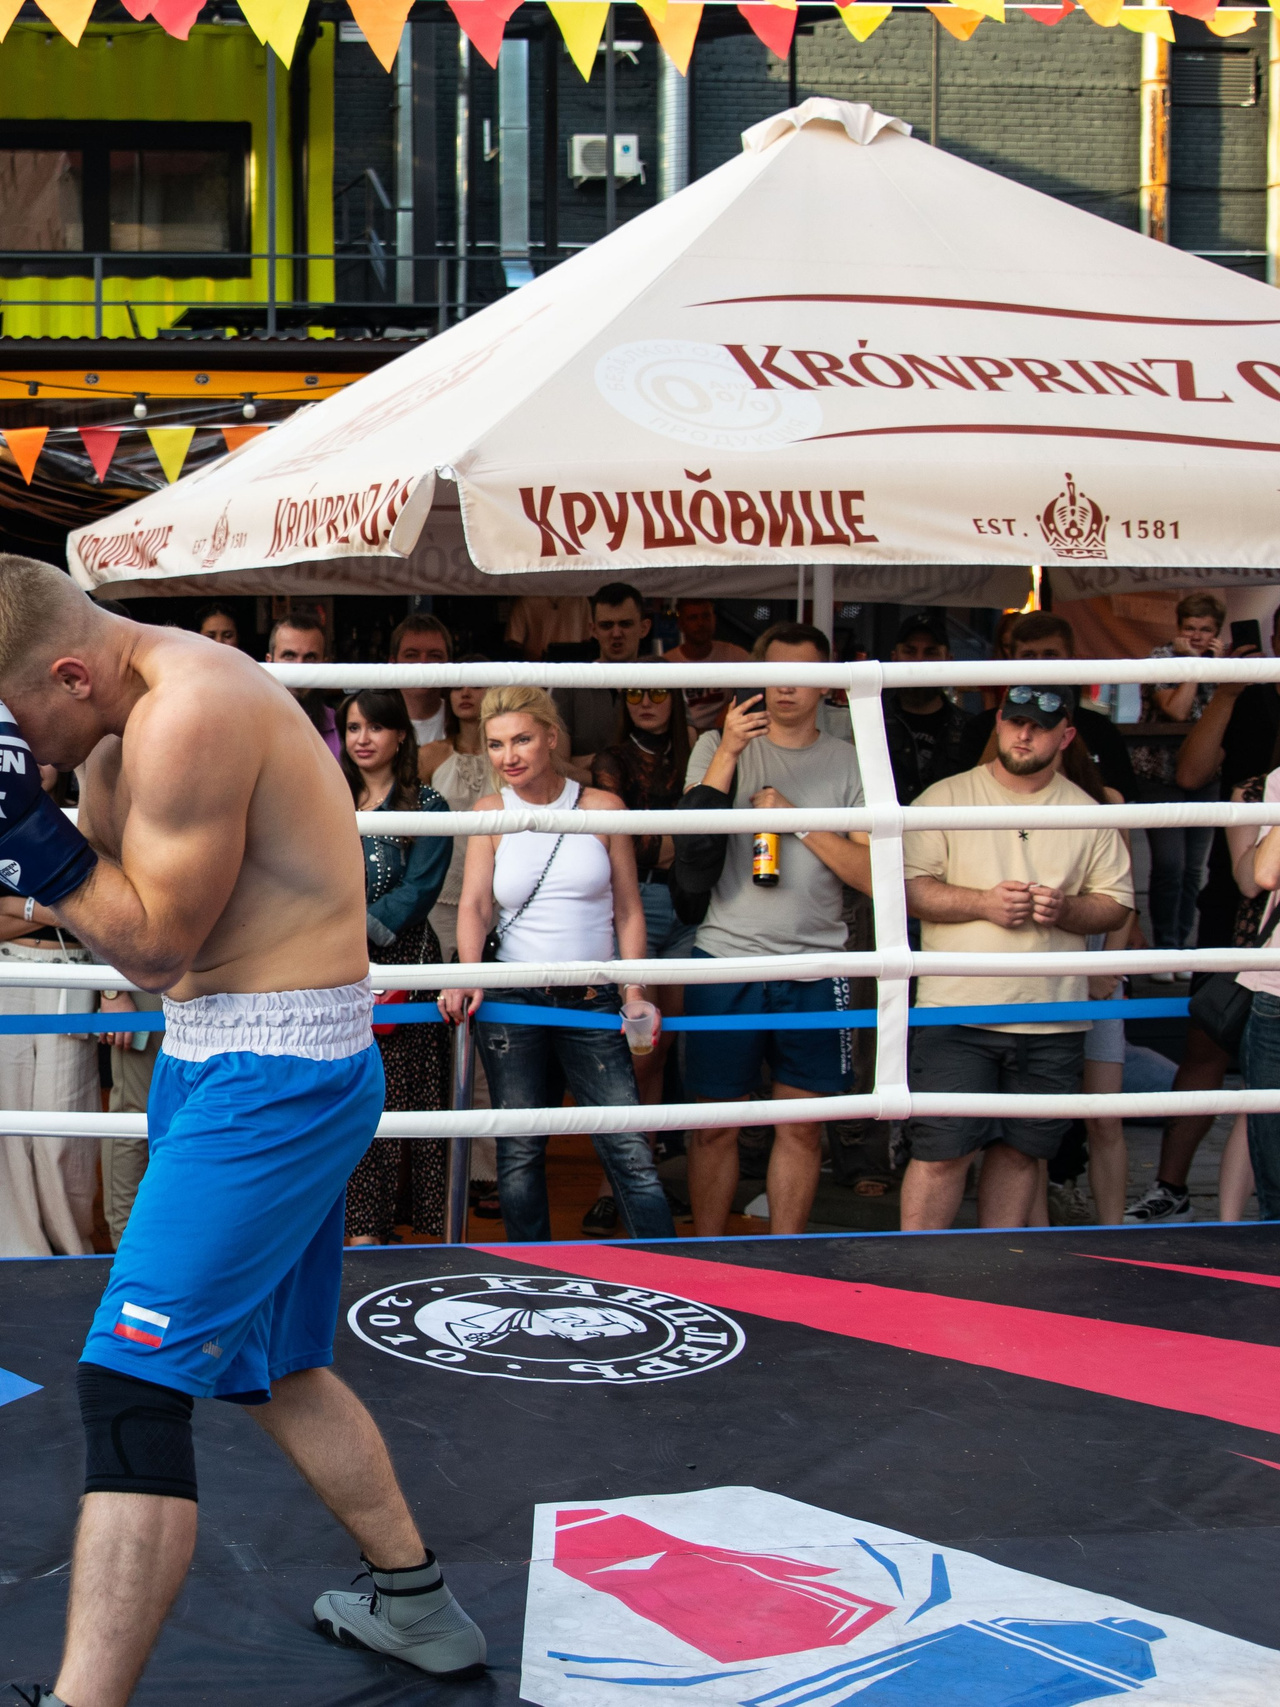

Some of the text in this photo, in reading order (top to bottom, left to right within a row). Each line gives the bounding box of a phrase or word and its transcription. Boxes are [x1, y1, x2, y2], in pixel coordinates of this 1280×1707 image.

[973, 518, 1180, 539] EST. 1581
[230, 532, 248, 550] 1581
